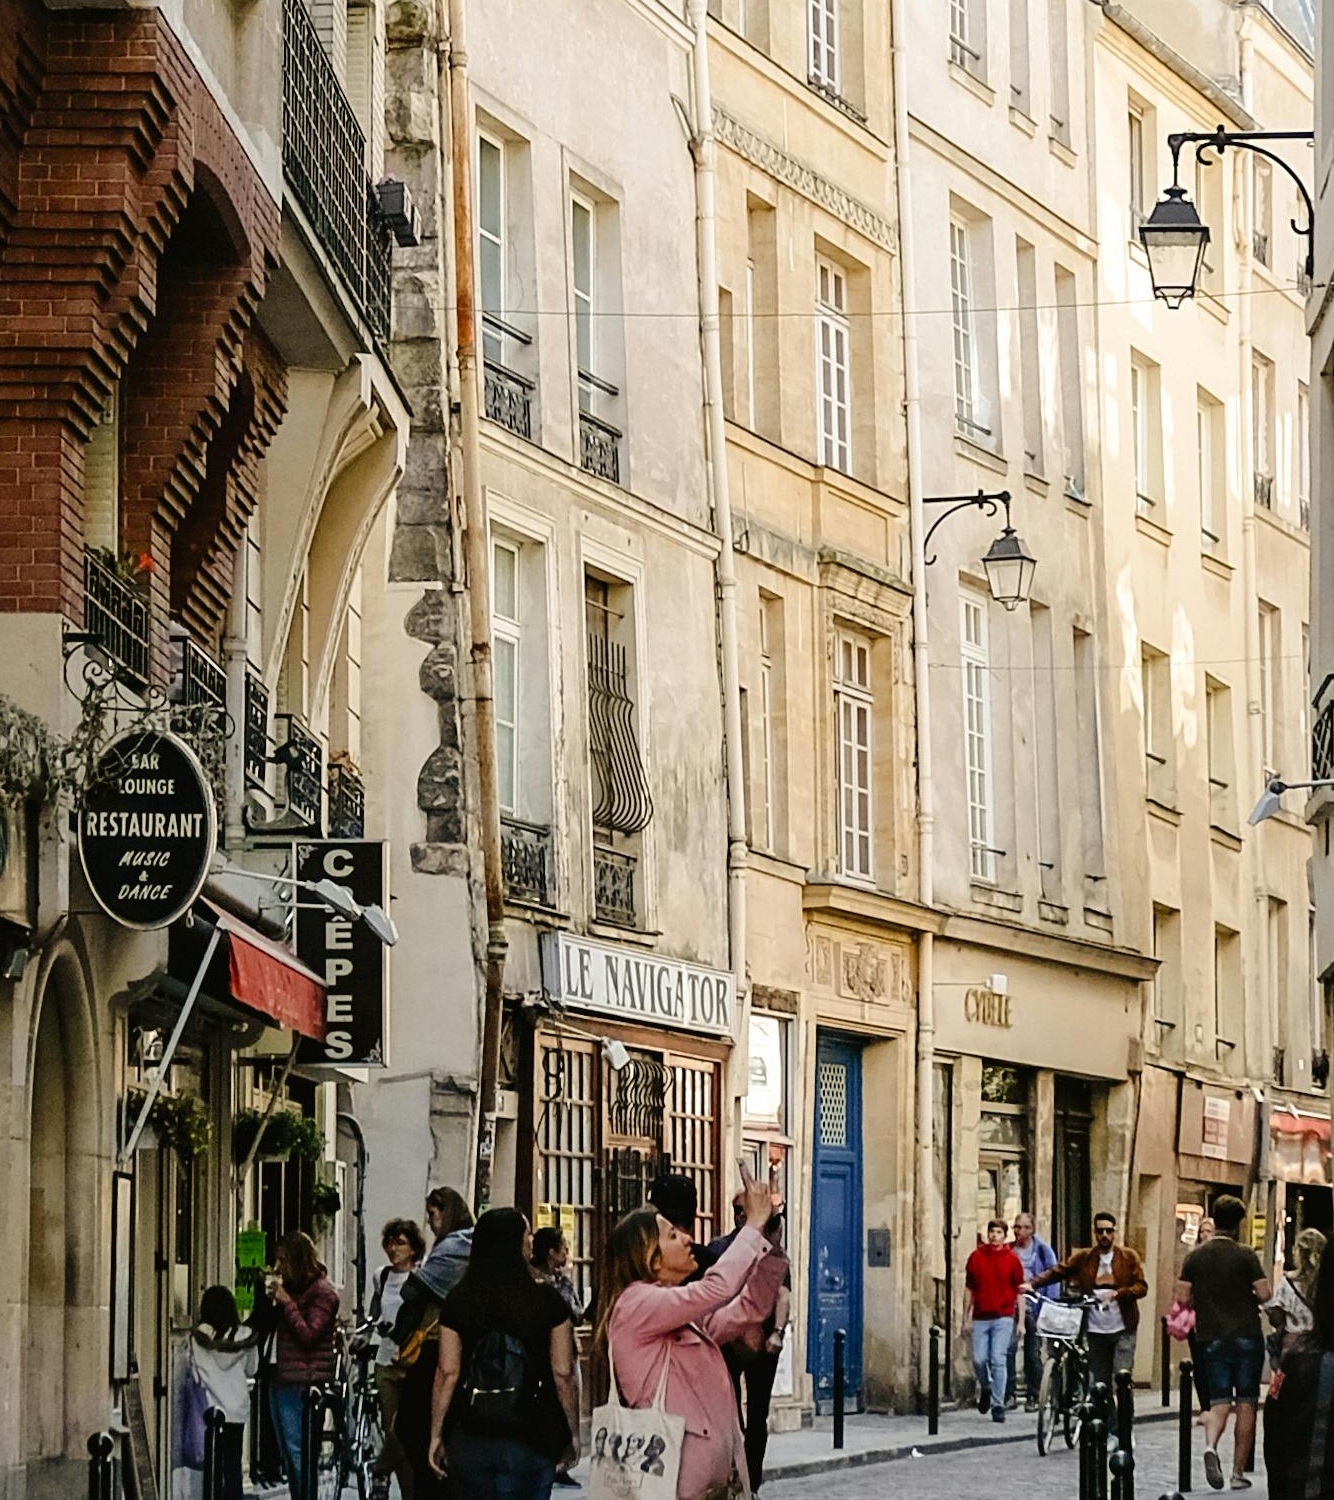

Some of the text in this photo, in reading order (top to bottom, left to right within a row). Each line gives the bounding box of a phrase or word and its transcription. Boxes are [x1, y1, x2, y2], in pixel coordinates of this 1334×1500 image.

[131, 753, 160, 770] BAR
[119, 779, 175, 795] LOUNGE
[86, 812, 204, 838] RESTAURANT
[118, 851, 171, 867] MUSIC
[138, 870, 149, 882] &
[118, 884, 173, 900] DANCE
[322, 849, 356, 1060] CÊPES
[565, 945, 729, 1027] LE NAVIGATOR
